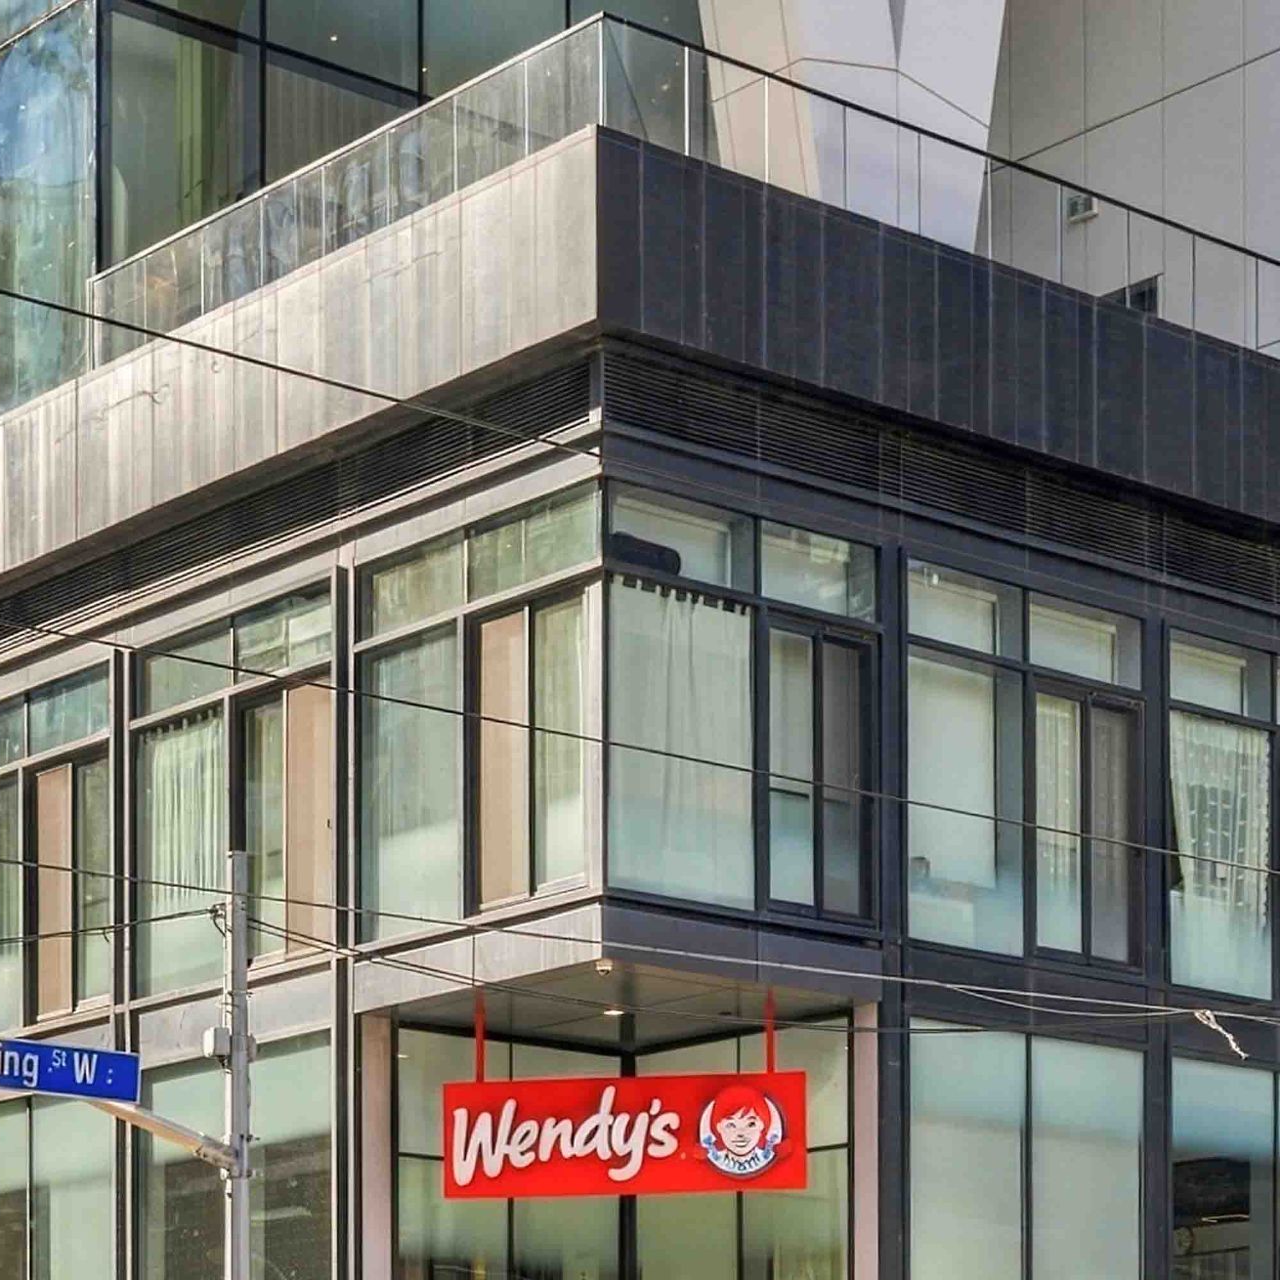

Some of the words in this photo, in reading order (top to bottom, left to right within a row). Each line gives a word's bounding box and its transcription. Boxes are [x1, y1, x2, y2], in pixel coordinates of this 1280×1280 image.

[51, 1050, 67, 1067] St
[73, 1052, 98, 1085] W
[452, 1085, 679, 1187] Wendy's
